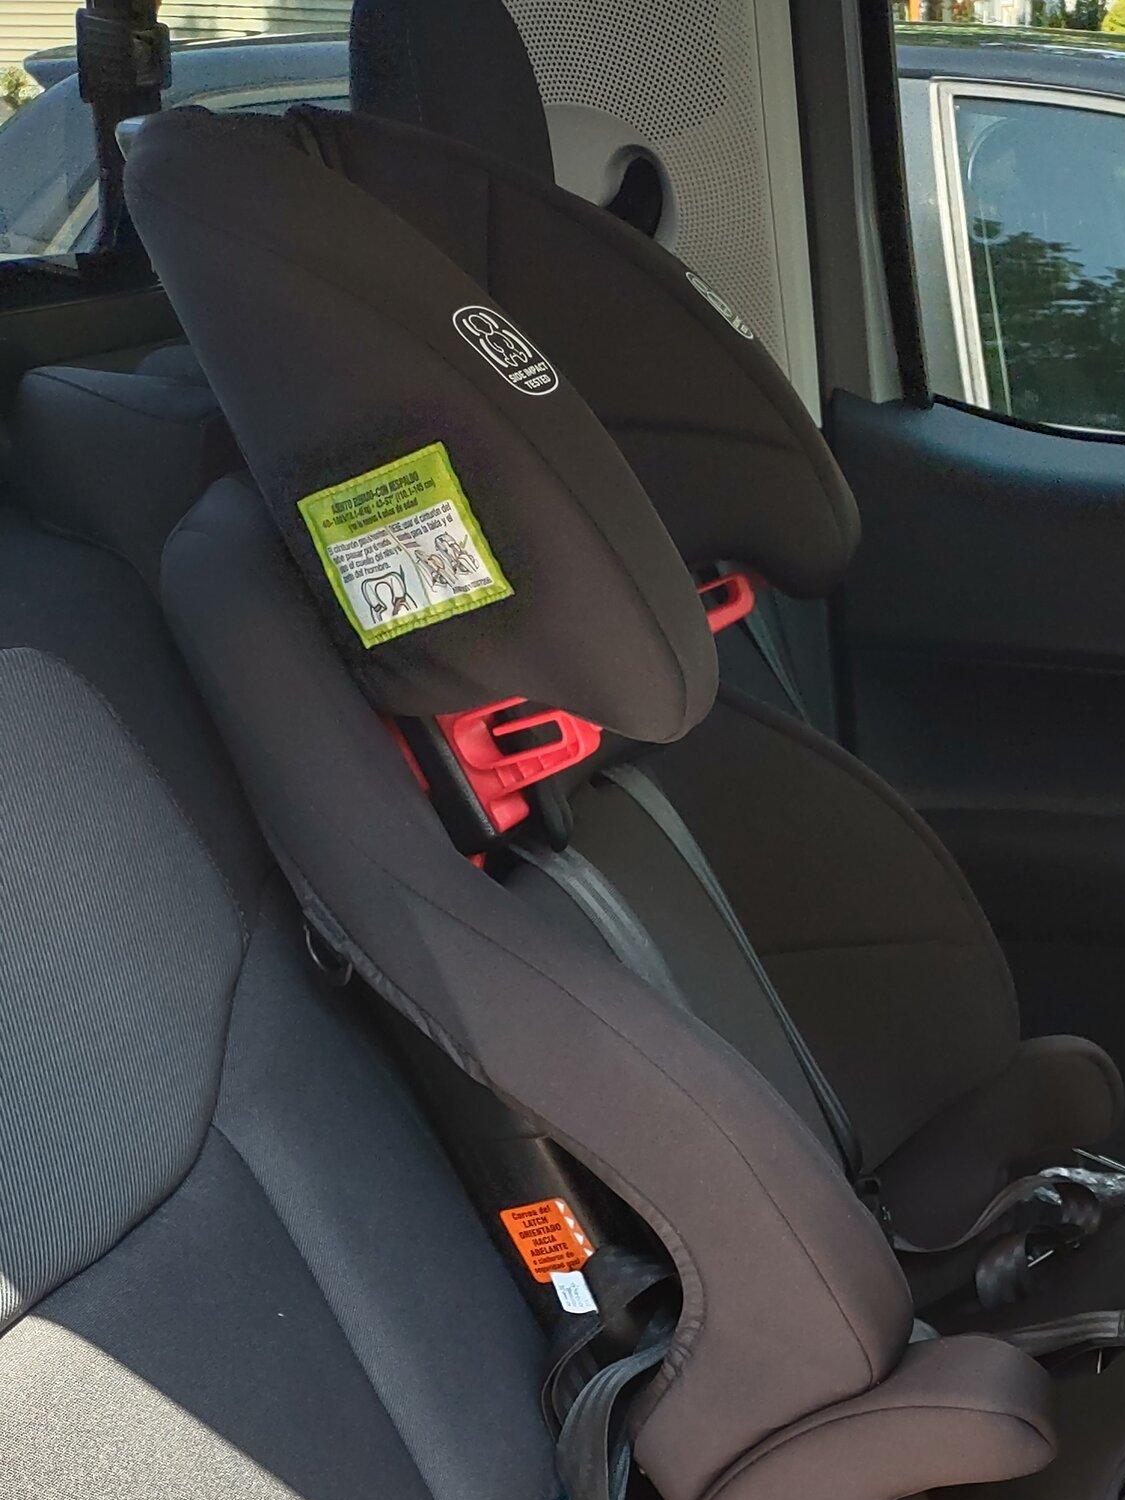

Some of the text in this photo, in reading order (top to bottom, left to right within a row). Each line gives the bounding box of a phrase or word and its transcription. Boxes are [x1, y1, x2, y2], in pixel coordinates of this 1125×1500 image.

[509, 362, 548, 383] SIDE IMPACT
[525, 375, 551, 390] TESTED
[441, 502, 451, 513] del
[512, 1205, 550, 1220] Correa del
[523, 1217, 549, 1228] LATCH
[519, 1224, 562, 1239] ORIENTADO
[532, 1235, 557, 1247] HACIA
[530, 1242, 569, 1257] ADELANTE
